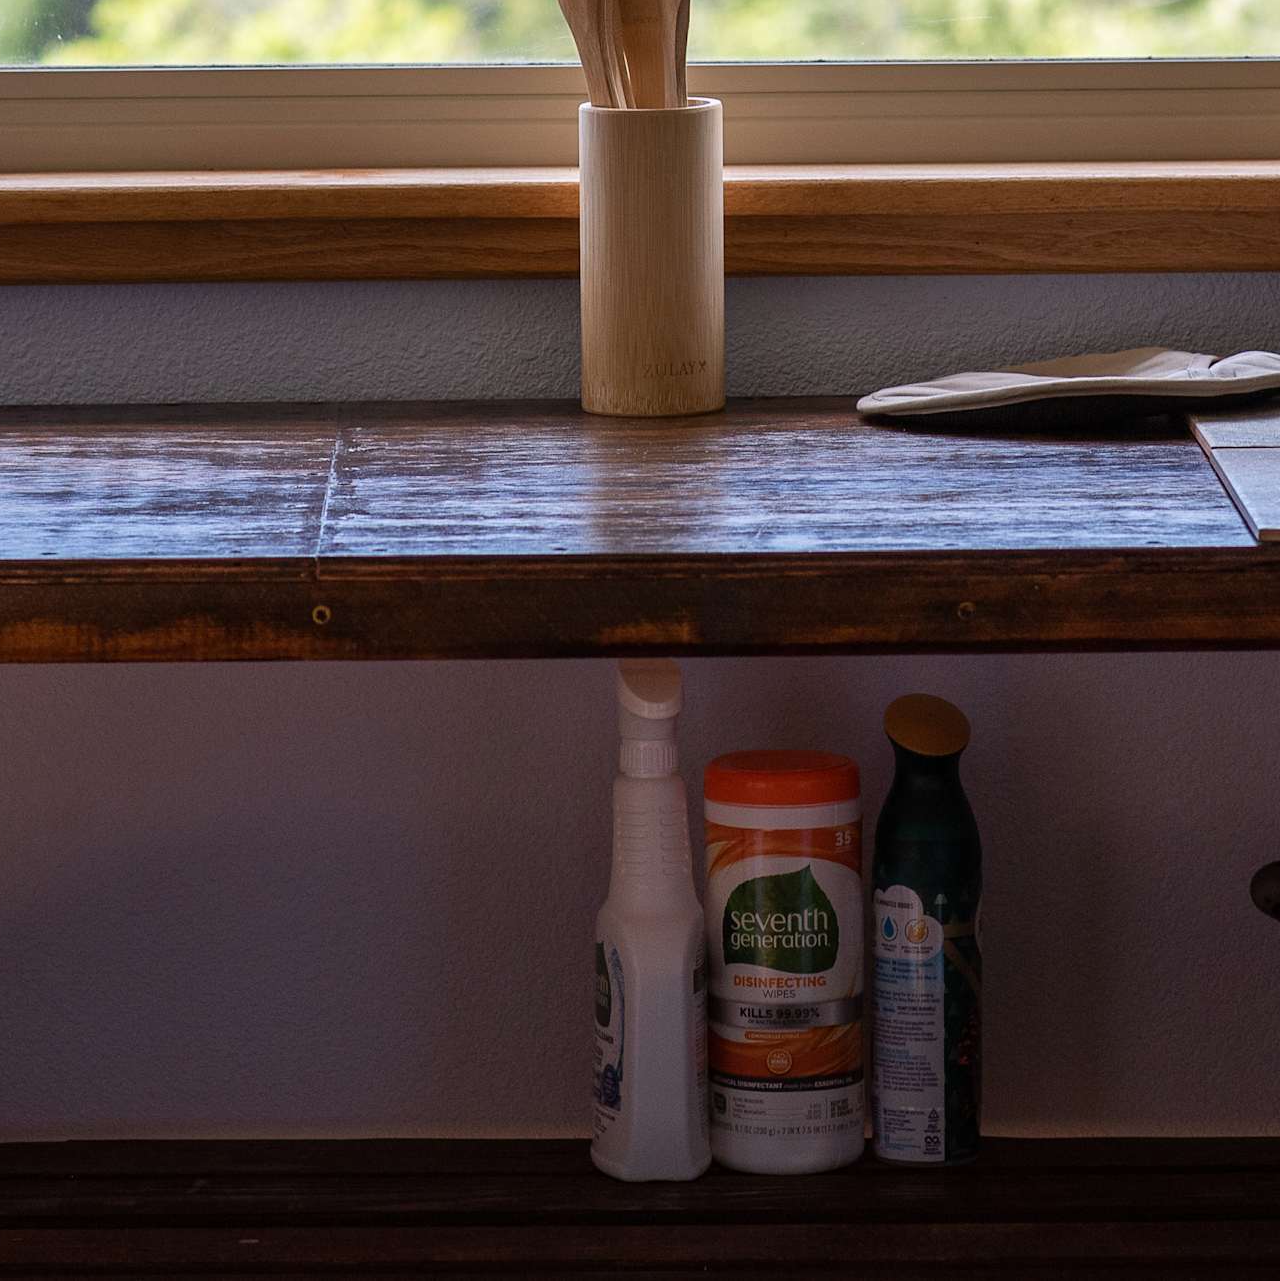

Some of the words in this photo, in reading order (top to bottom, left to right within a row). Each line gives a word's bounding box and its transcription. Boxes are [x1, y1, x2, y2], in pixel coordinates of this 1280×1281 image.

[834, 830, 852, 847] 35
[730, 908, 828, 932] seventh
[730, 932, 830, 951] generation
[734, 975, 827, 988] DISINFECTING
[762, 989, 796, 998] WIPES
[739, 1007, 773, 1018] KILLS
[775, 1007, 820, 1019] 99.99%
